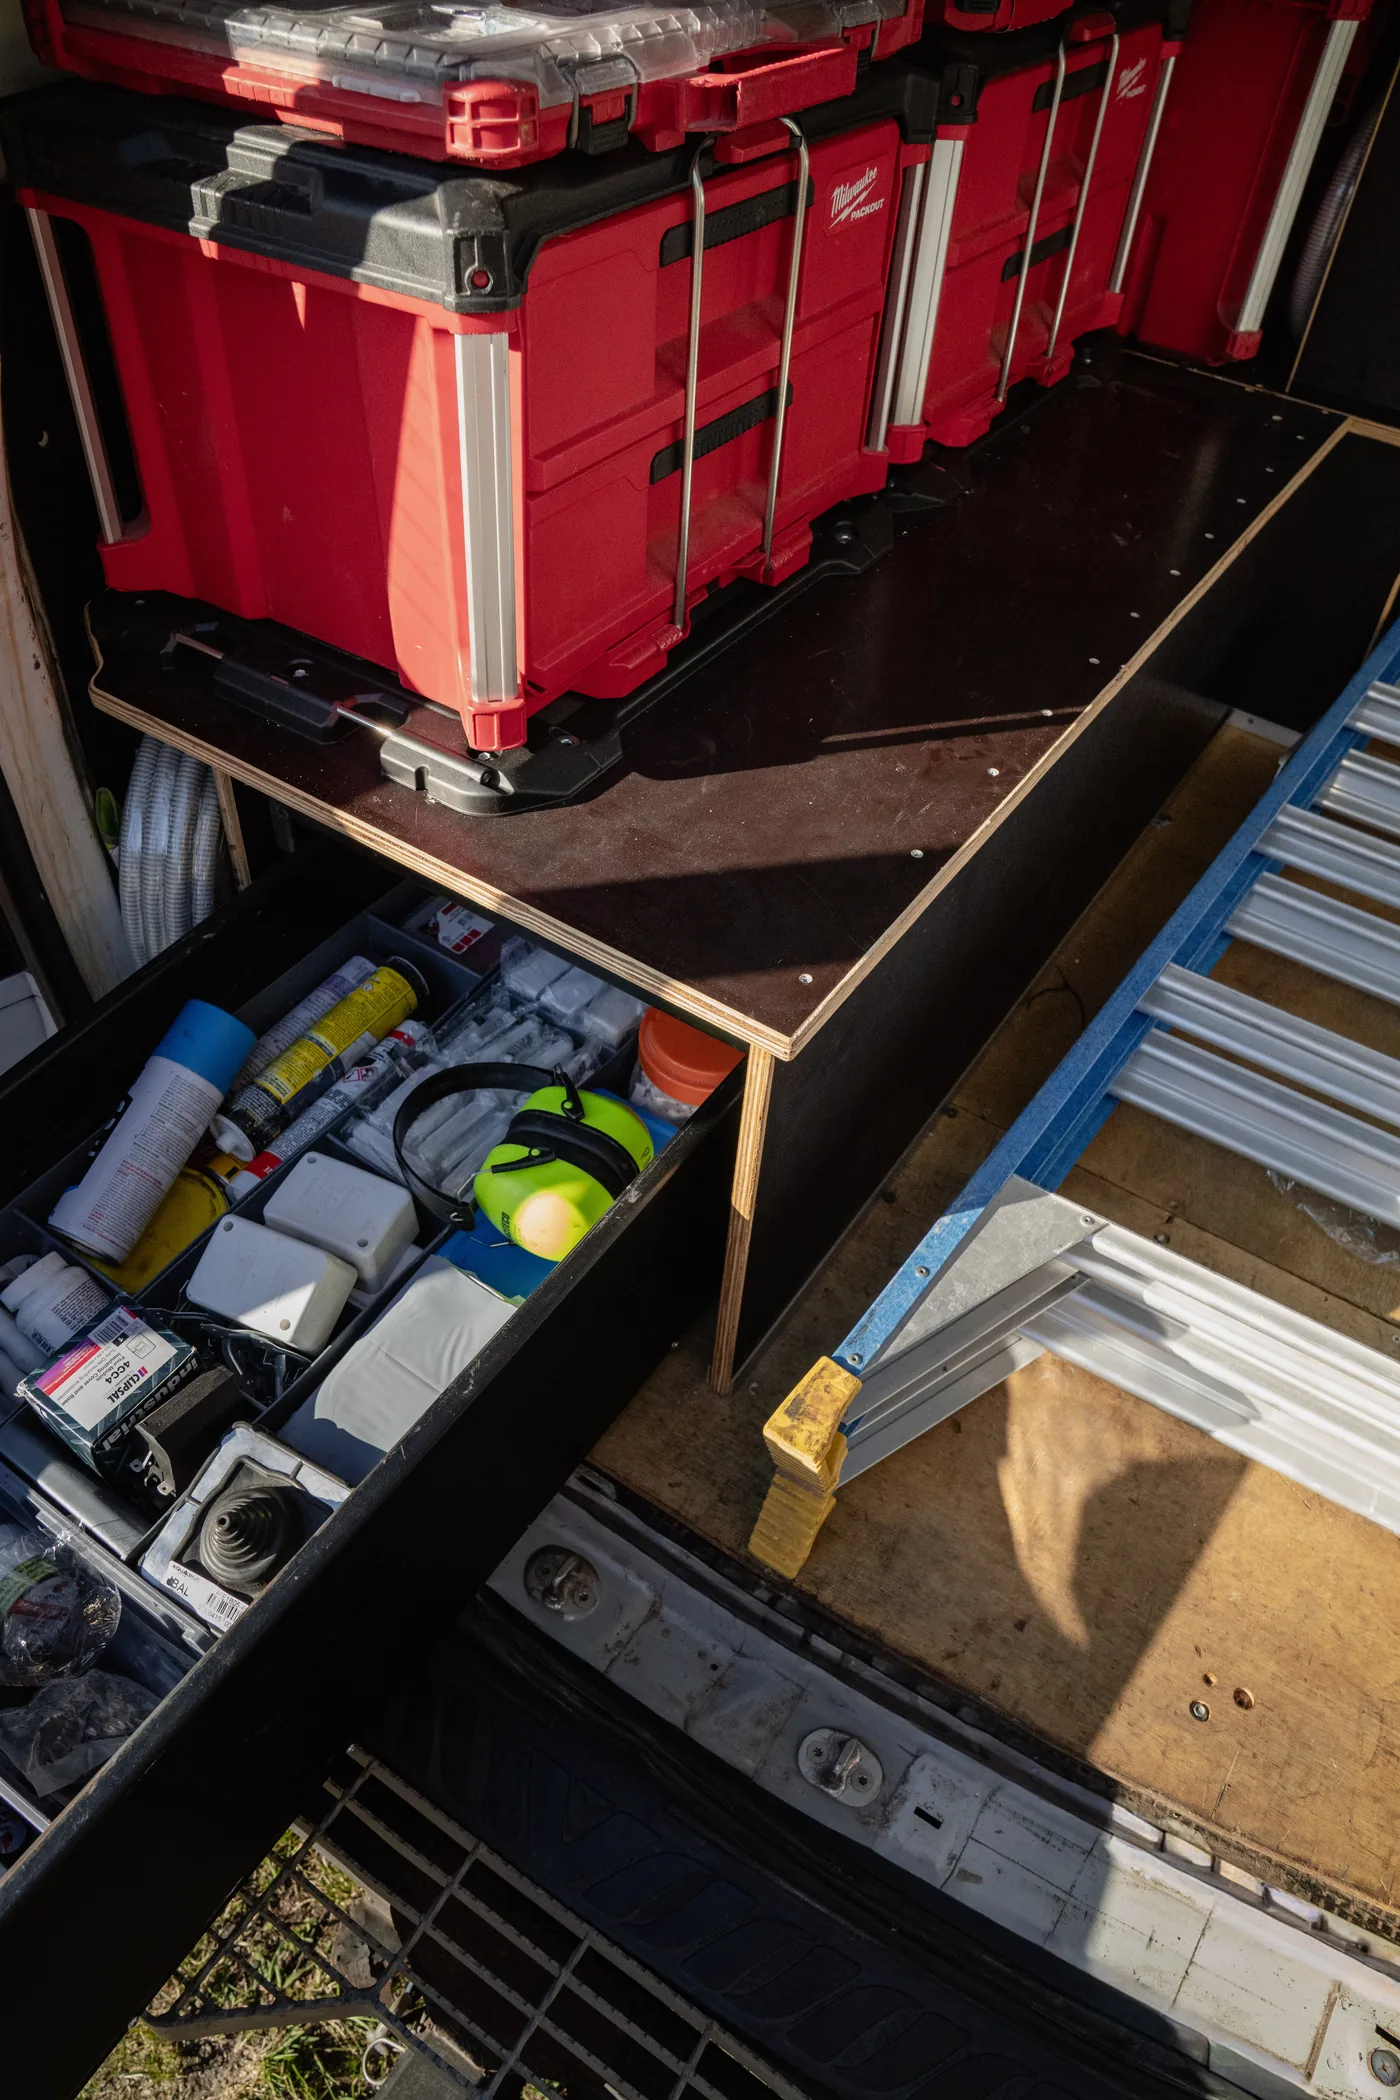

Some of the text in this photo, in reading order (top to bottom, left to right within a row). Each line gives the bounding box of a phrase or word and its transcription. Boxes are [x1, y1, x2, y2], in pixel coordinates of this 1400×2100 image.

[830, 167, 878, 218] Milwaukee
[851, 198, 884, 221] PACKOUT
[96, 1351, 121, 1373] Insulating
[104, 1360, 131, 1384] 4CC4
[73, 1385, 83, 1394] and
[83, 1372, 98, 1385] Cover
[106, 1372, 140, 1404] CLIPSAL
[101, 1357, 197, 1451] industrial
